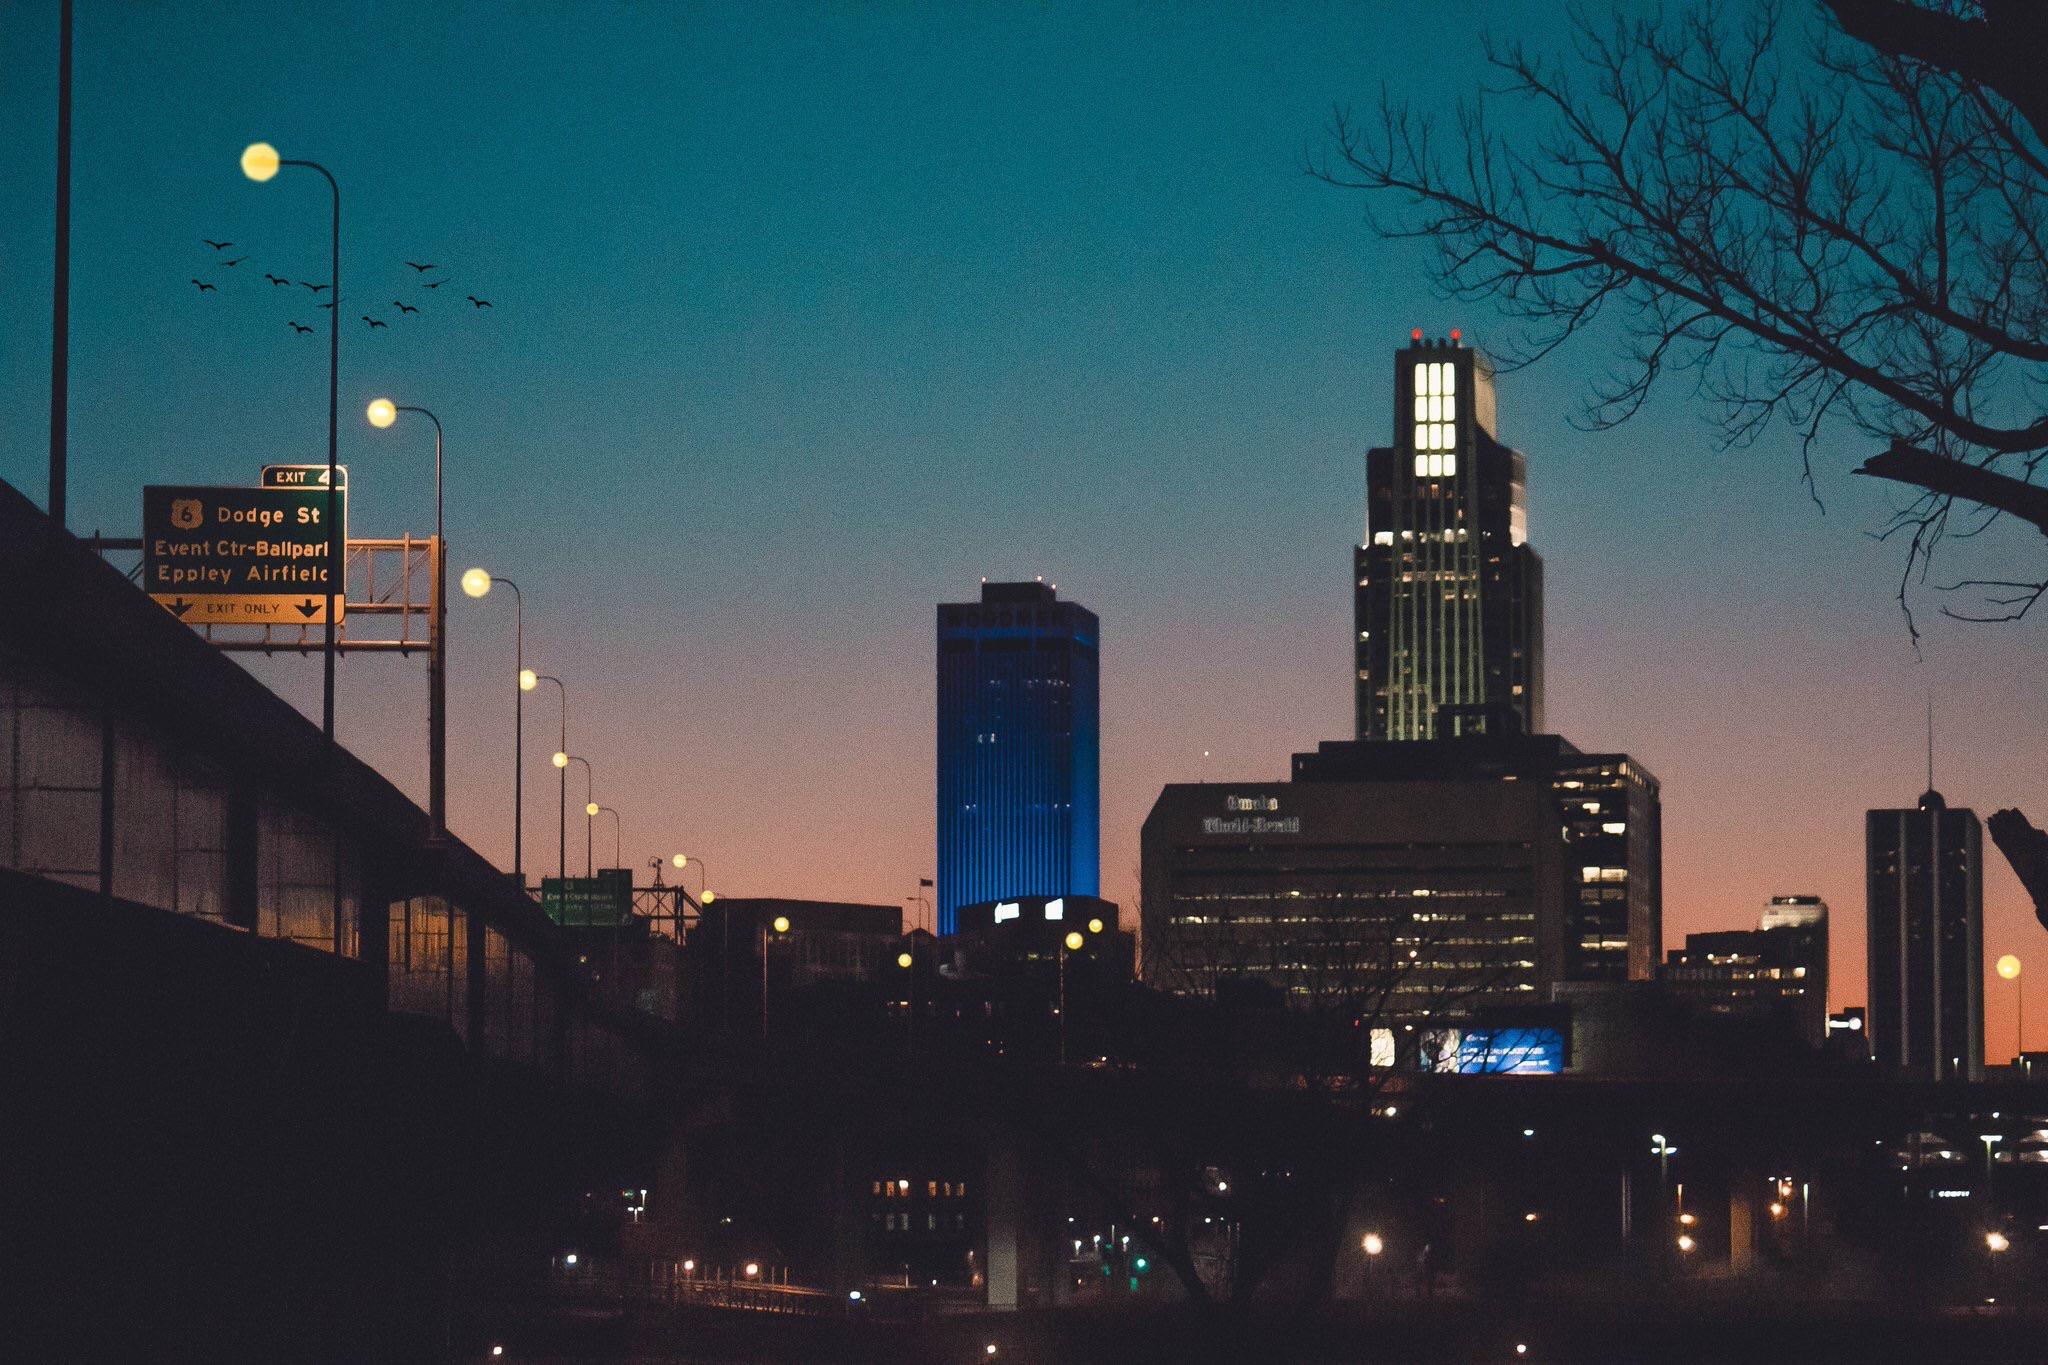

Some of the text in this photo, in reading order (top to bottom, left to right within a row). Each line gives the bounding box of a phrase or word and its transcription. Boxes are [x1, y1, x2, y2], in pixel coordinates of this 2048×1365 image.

[276, 470, 330, 485] EXIT 4
[181, 506, 192, 523] 6
[218, 506, 320, 528] Dodge St
[155, 540, 210, 557] Event
[158, 564, 232, 584] Eppley
[207, 603, 280, 614] EXIT ONLY
